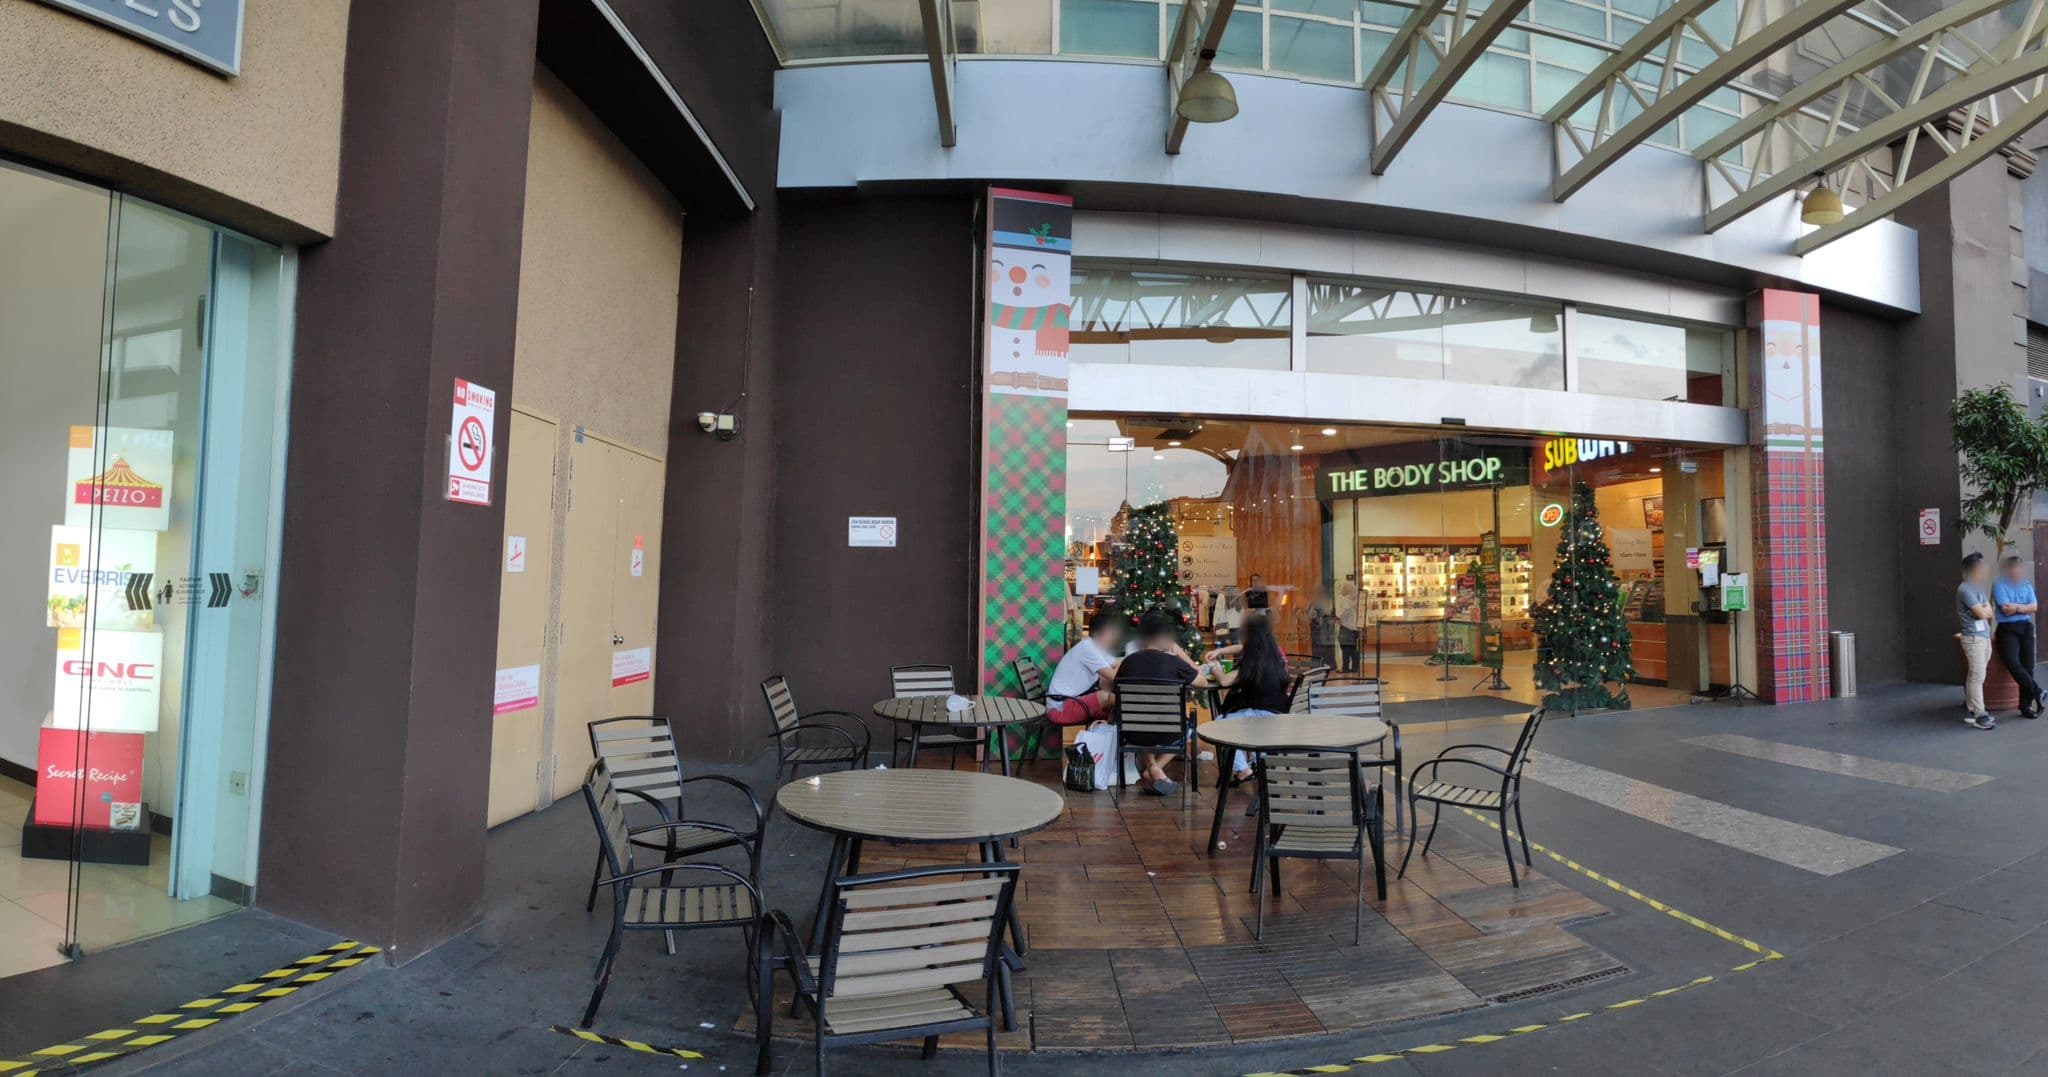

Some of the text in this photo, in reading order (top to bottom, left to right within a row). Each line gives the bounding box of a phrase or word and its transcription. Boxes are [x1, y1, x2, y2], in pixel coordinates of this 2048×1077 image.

[1328, 470, 1368, 493] THE
[1374, 463, 1435, 489] BODY
[93, 487, 146, 504] PEZZO
[63, 660, 154, 679] GNC
[46, 764, 128, 786] Secret Recipe
